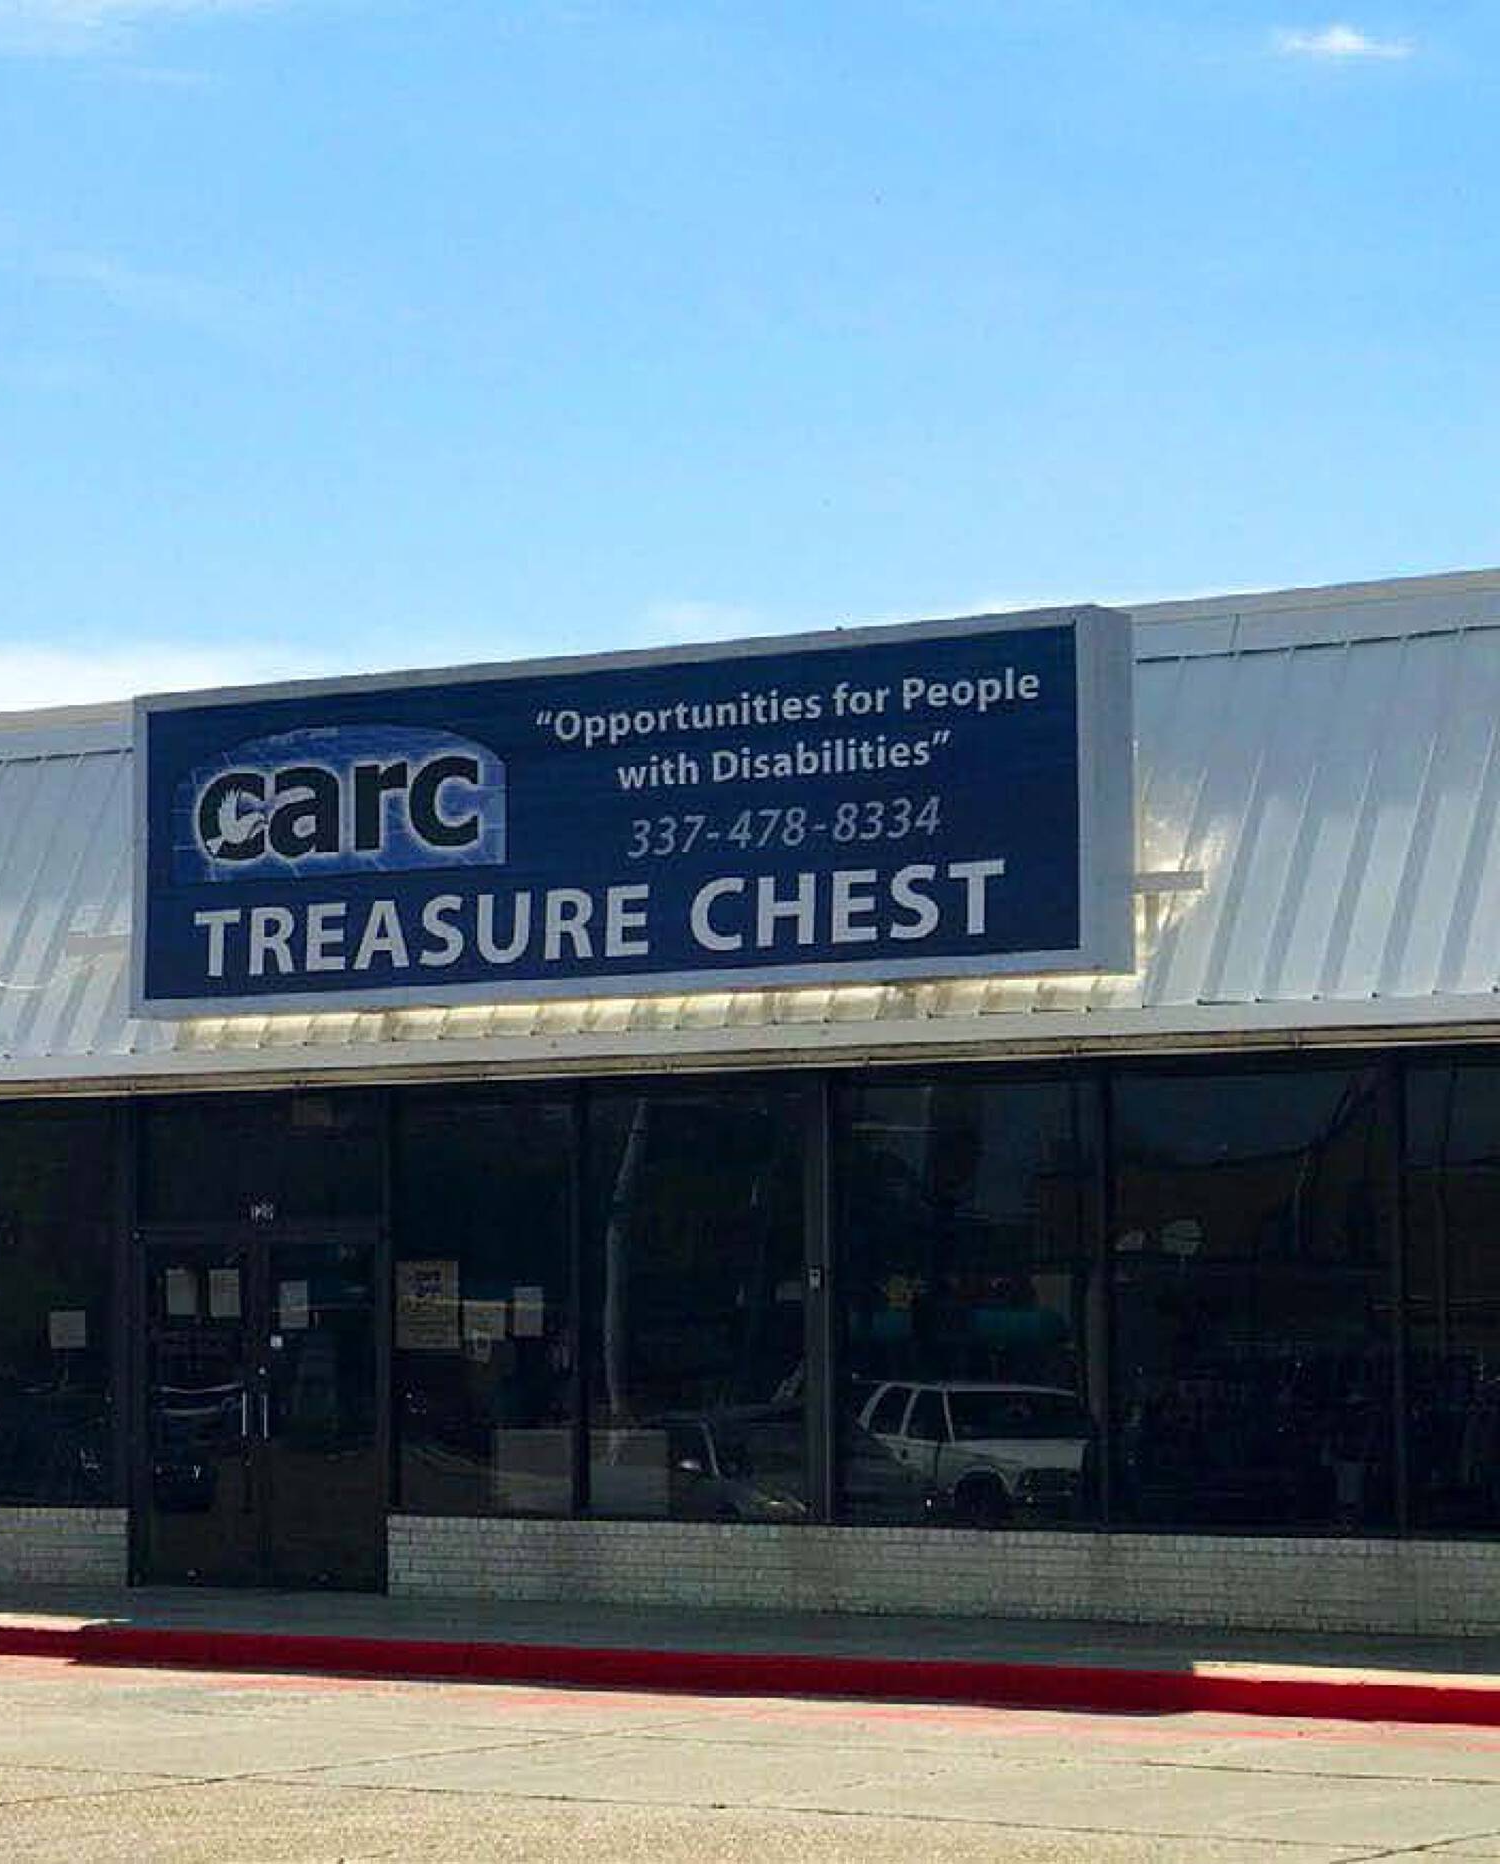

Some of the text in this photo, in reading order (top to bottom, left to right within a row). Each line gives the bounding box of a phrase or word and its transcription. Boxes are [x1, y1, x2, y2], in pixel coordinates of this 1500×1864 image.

[832, 682, 891, 717] for
[901, 666, 1041, 713] People
[617, 755, 700, 791] with
[627, 795, 942, 859] 337-478-8334
[194, 858, 1007, 978] TREASURE CHEST
